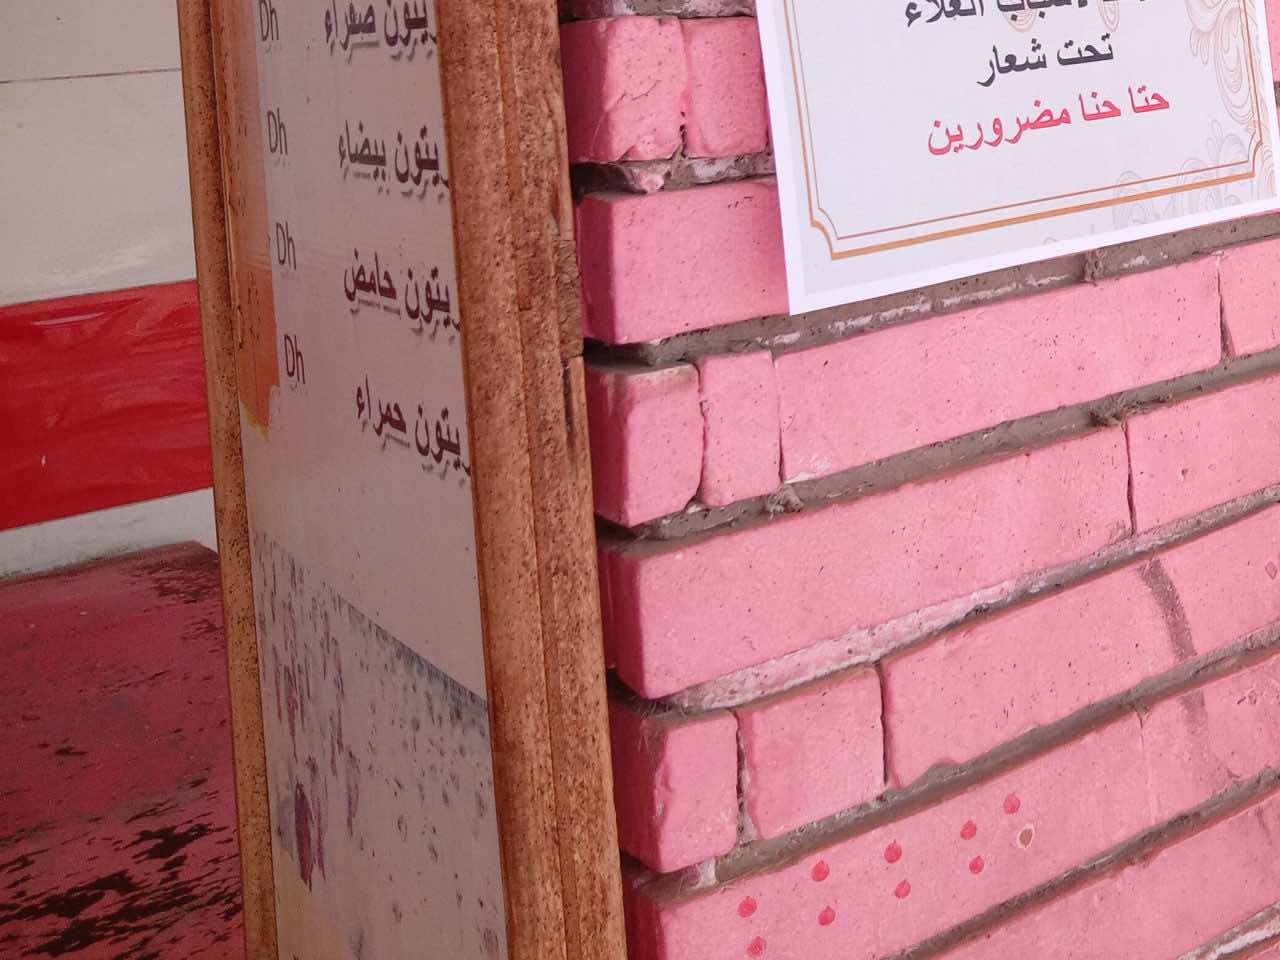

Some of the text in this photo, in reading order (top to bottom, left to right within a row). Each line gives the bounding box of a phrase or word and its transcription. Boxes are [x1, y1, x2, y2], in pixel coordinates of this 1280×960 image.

[976, 32, 1115, 87] تحت شعار
[267, 108, 288, 155] Dh
[928, 83, 1170, 155] حتا حنا مضرورين
[338, 120, 449, 187] يتون بيضاء
[276, 221, 296, 270] Dh
[344, 248, 460, 330] يتون حامض
[284, 334, 305, 384] Dh
[357, 374, 471, 476] يتون حمراء
